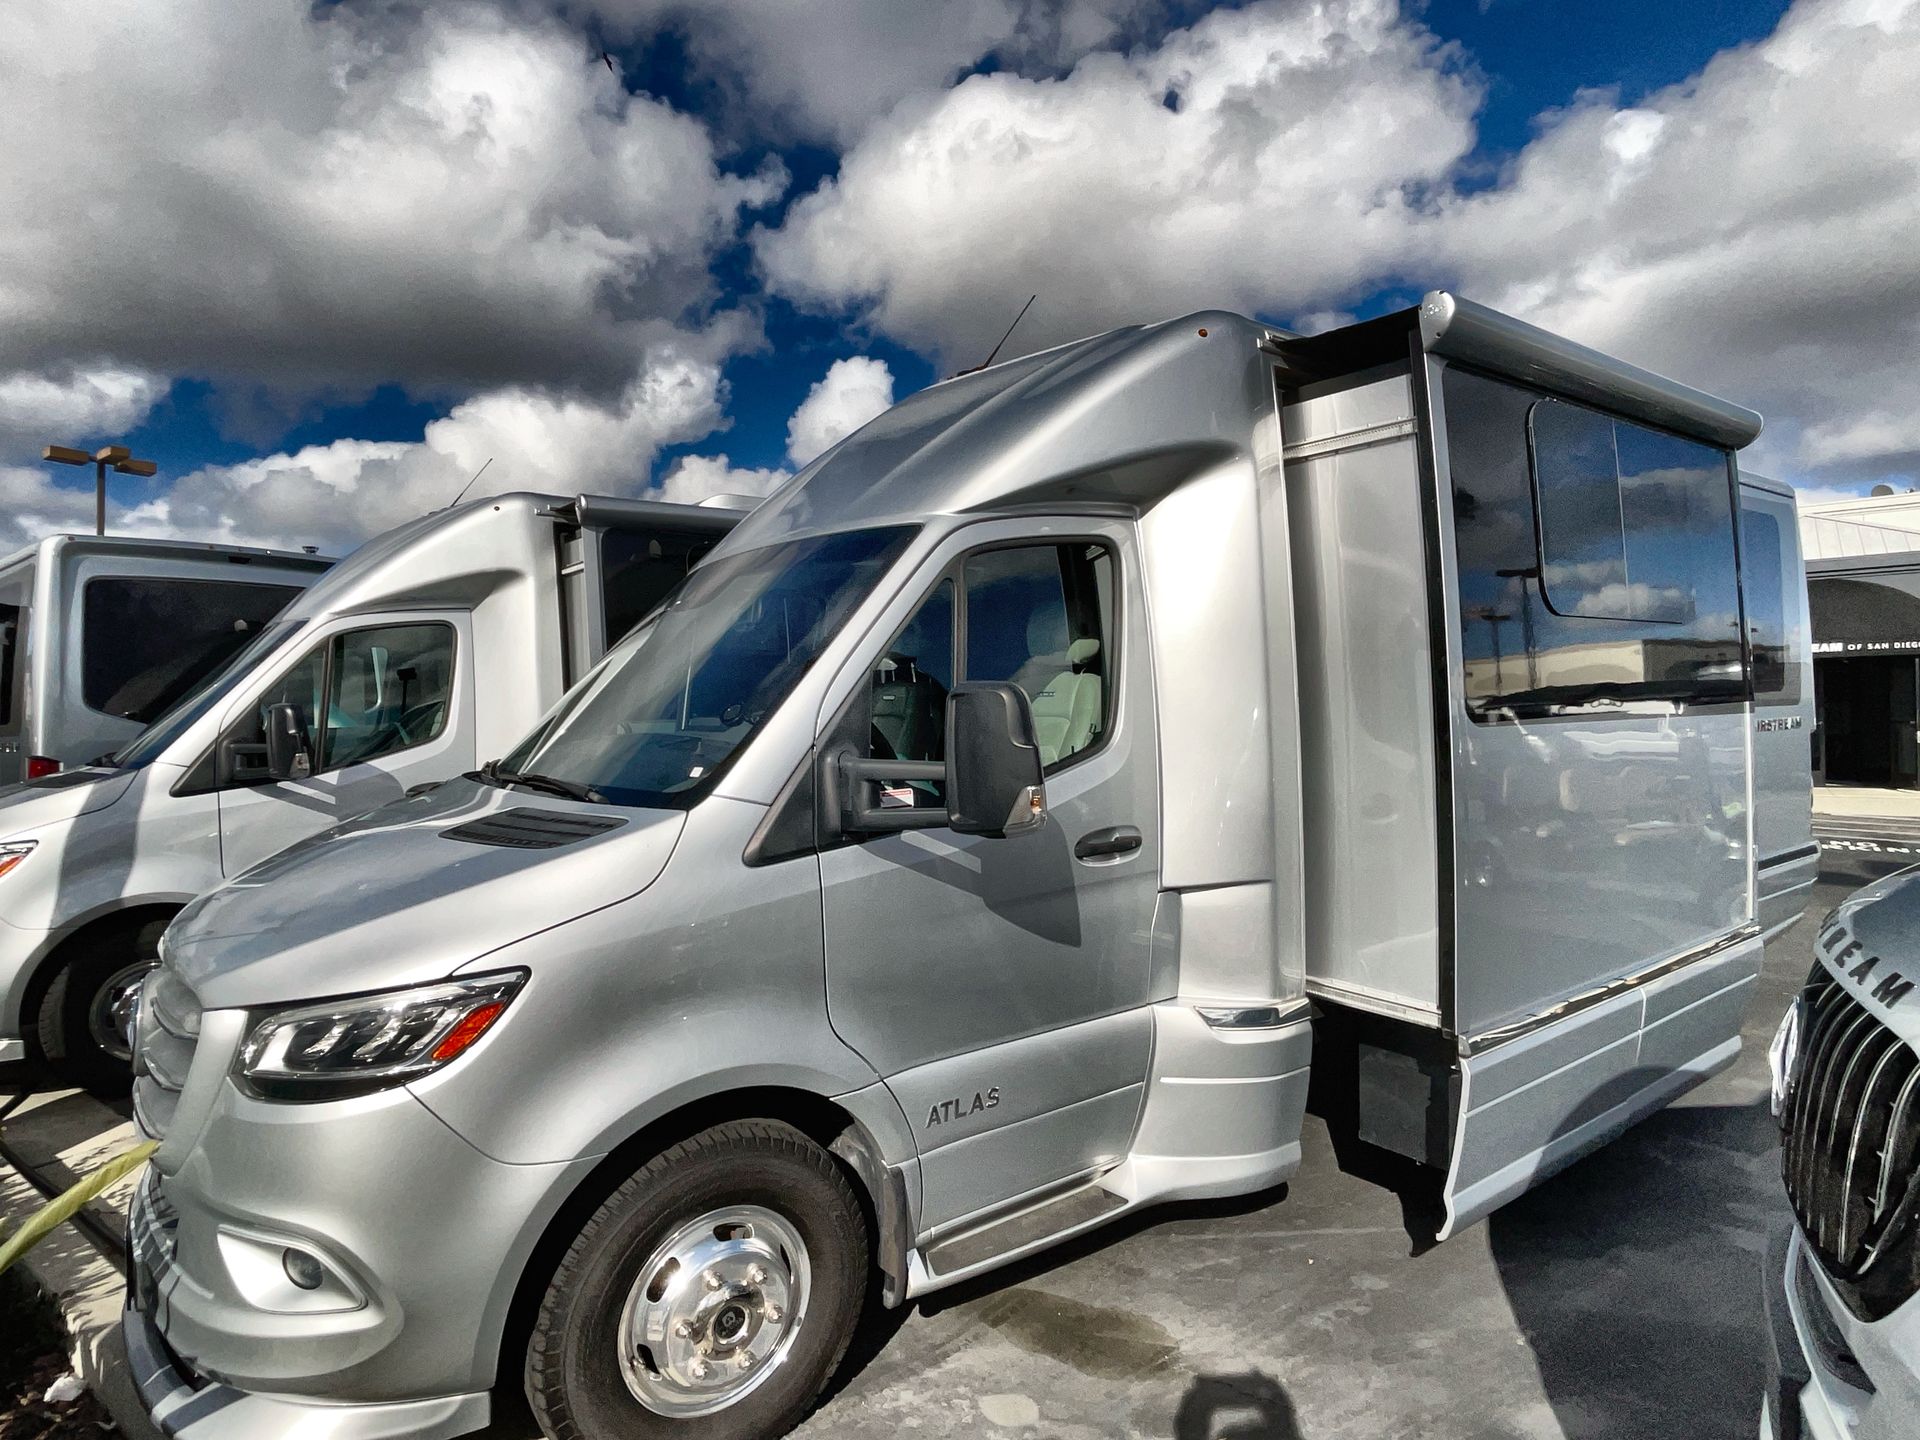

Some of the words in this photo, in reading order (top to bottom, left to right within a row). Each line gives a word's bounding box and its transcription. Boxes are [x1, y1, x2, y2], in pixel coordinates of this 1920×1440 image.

[1847, 643, 1863, 651] OF
[1867, 642, 1889, 650] SAN
[1893, 641, 1920, 649] DIEG
[925, 1086, 1000, 1128] ATLAS
